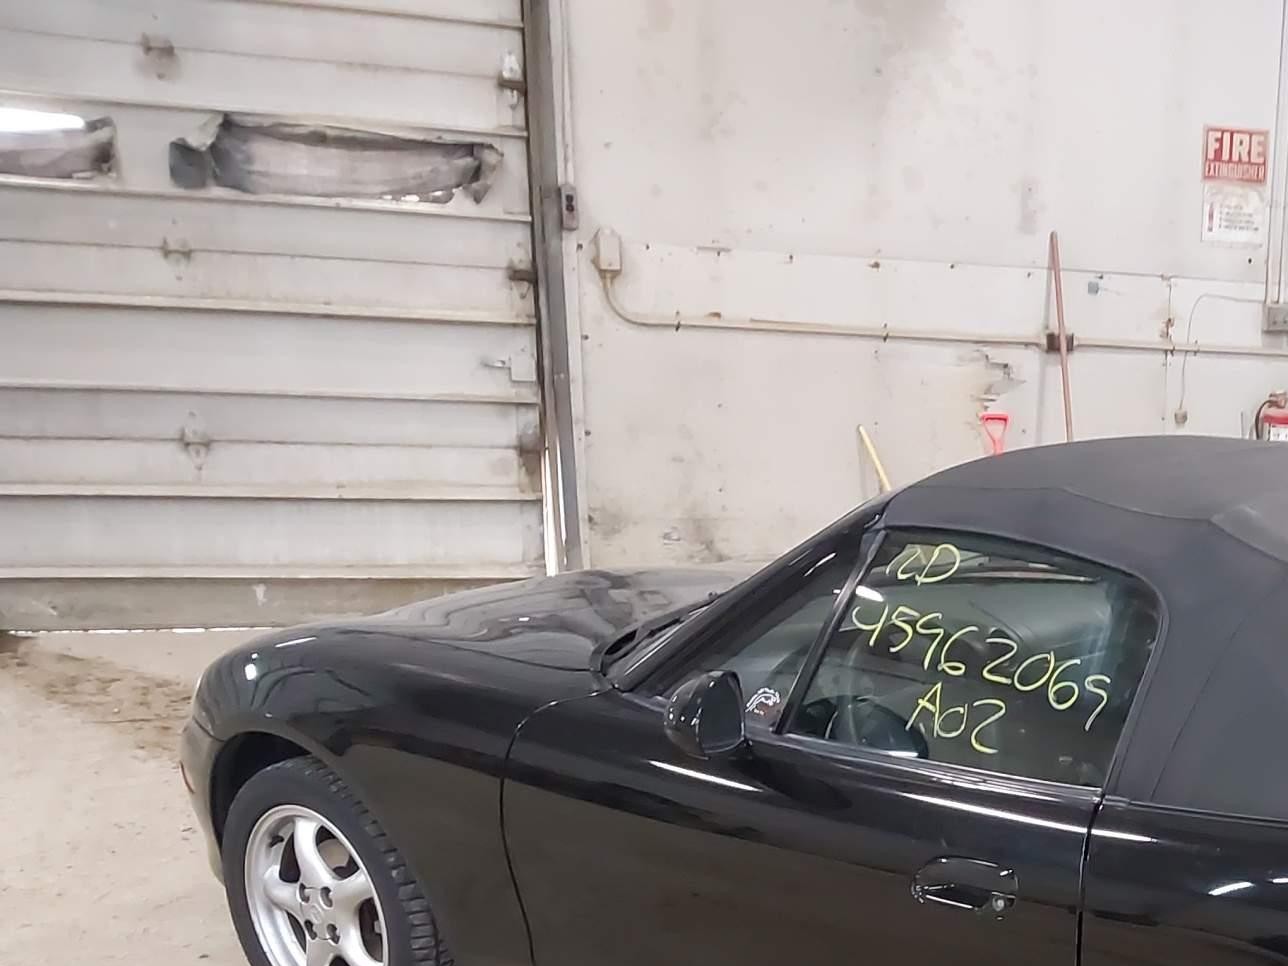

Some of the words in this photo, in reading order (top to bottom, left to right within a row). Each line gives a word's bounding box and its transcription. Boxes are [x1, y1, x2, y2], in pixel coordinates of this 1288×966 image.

[1205, 160, 1265, 179] EXTINGUISHER
[1206, 129, 1265, 164] FIRE
[852, 603, 1111, 731] 45962069
[905, 681, 1007, 754] A02
